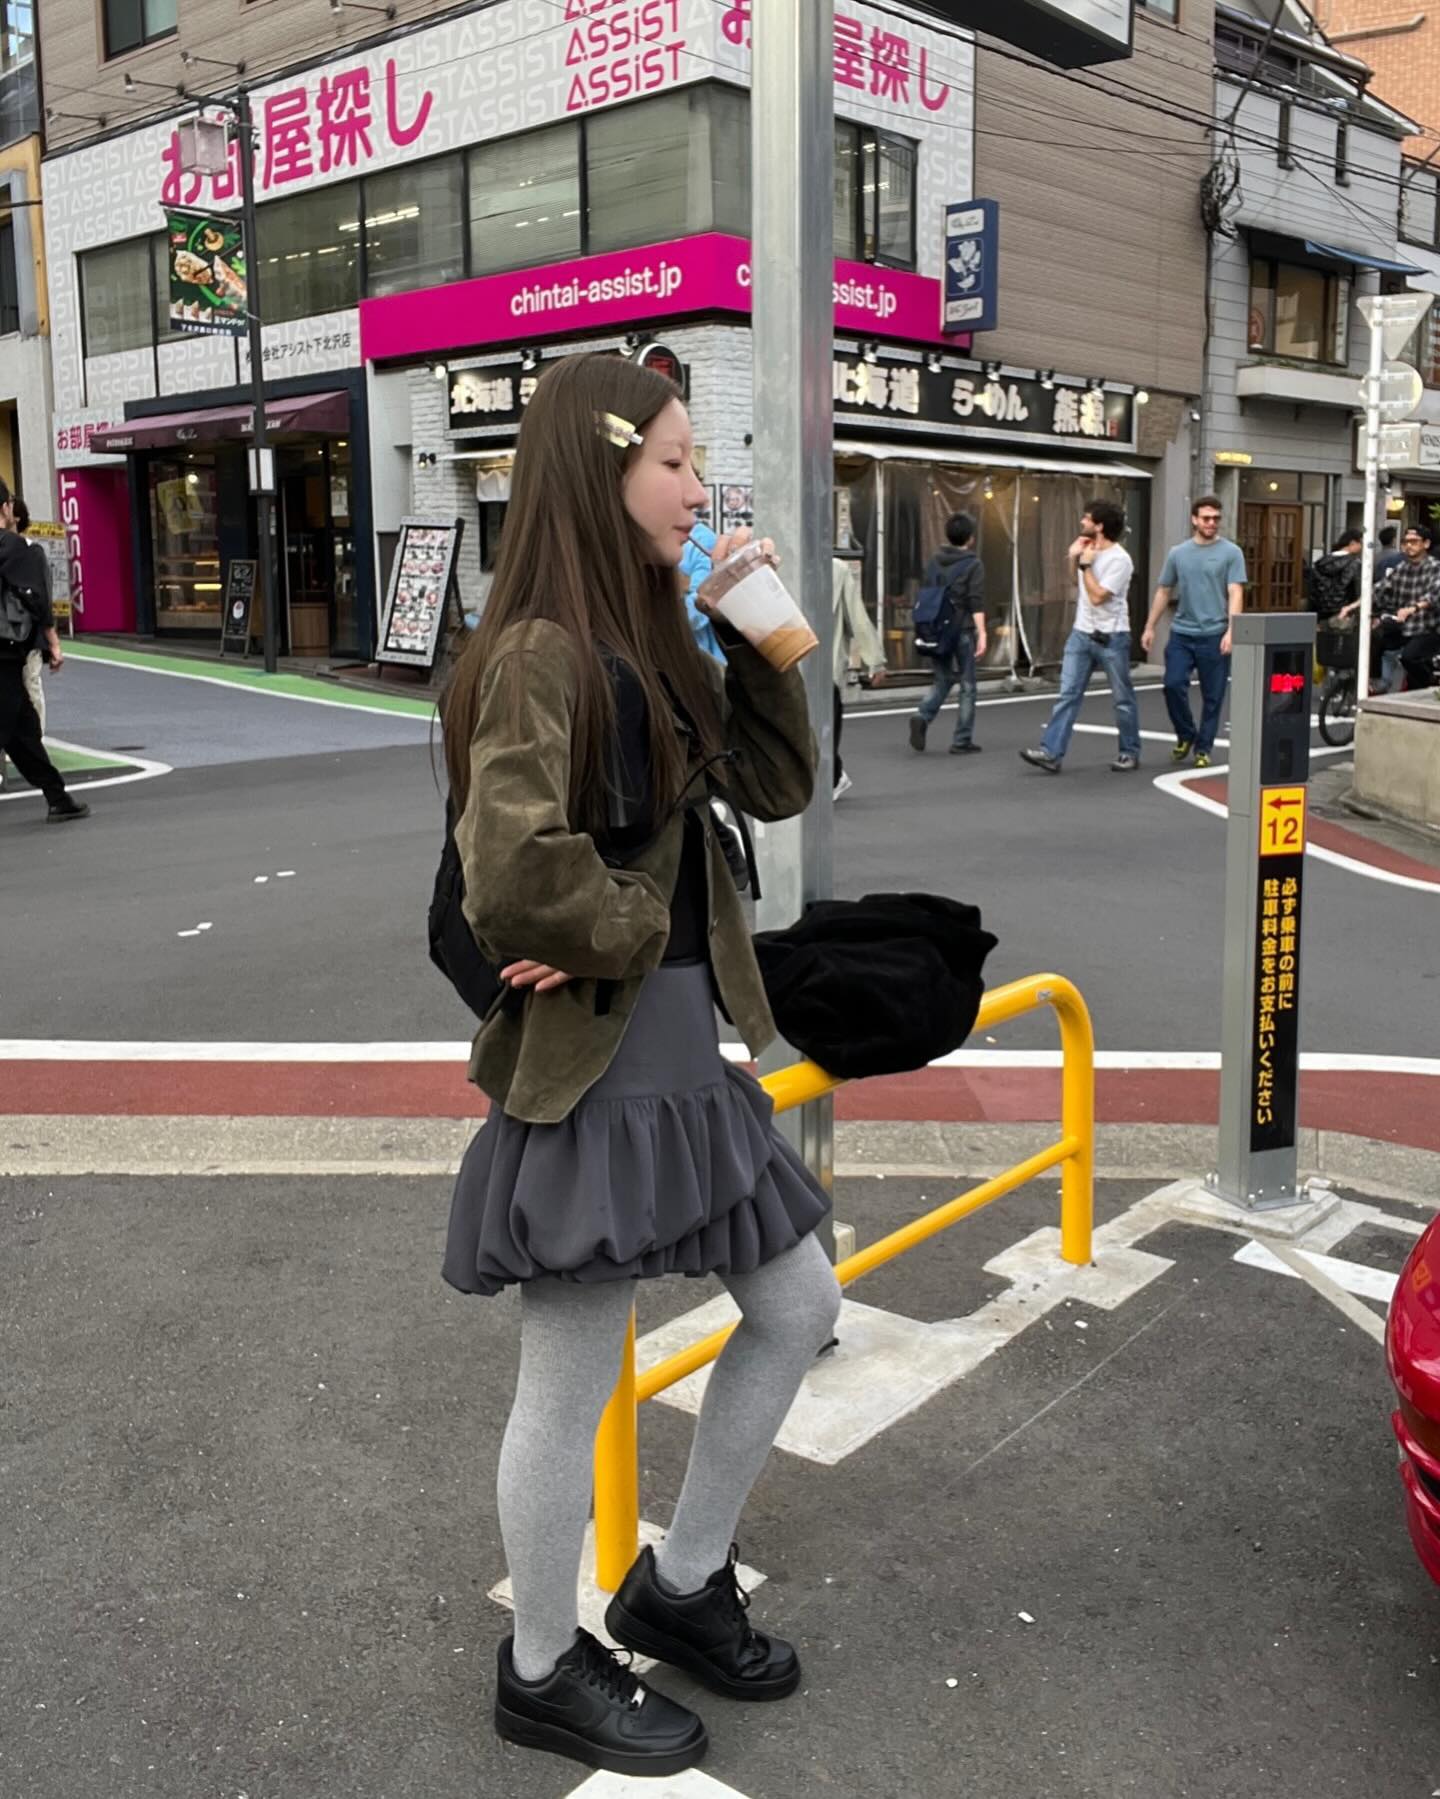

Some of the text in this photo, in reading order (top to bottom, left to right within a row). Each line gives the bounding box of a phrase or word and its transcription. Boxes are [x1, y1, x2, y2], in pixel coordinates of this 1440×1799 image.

[510, 260, 683, 316] chintai-assist.jp
[1267, 817, 1298, 846] 12
[1278, 877, 1298, 1010] 必ず乗車の前に
[1256, 879, 1279, 1126] 駐車料金をお支払いください
